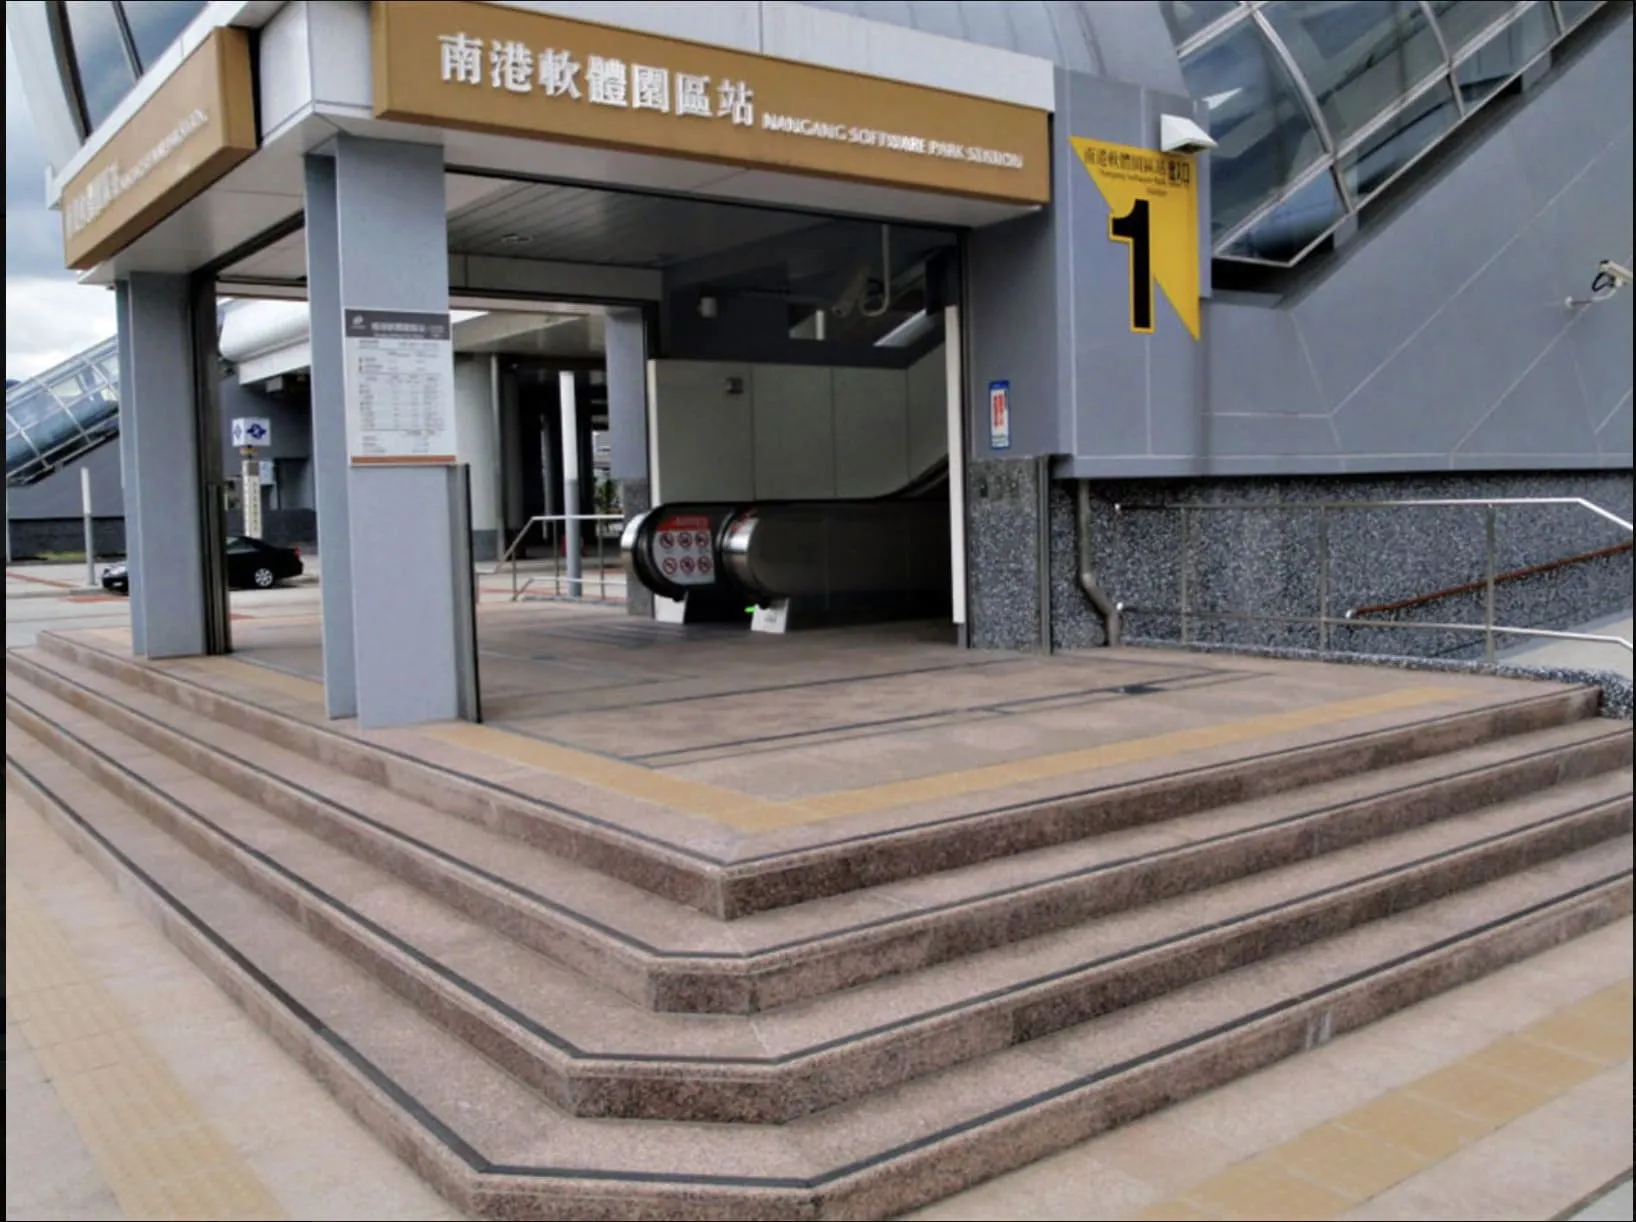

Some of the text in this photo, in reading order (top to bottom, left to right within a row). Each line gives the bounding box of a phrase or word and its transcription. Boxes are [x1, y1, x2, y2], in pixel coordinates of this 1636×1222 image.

[437, 32, 755, 126] 南港軟體園區站
[761, 111, 1024, 169] NANGANG SOFTWARE PARK STATION
[1112, 198, 1151, 329] 1
